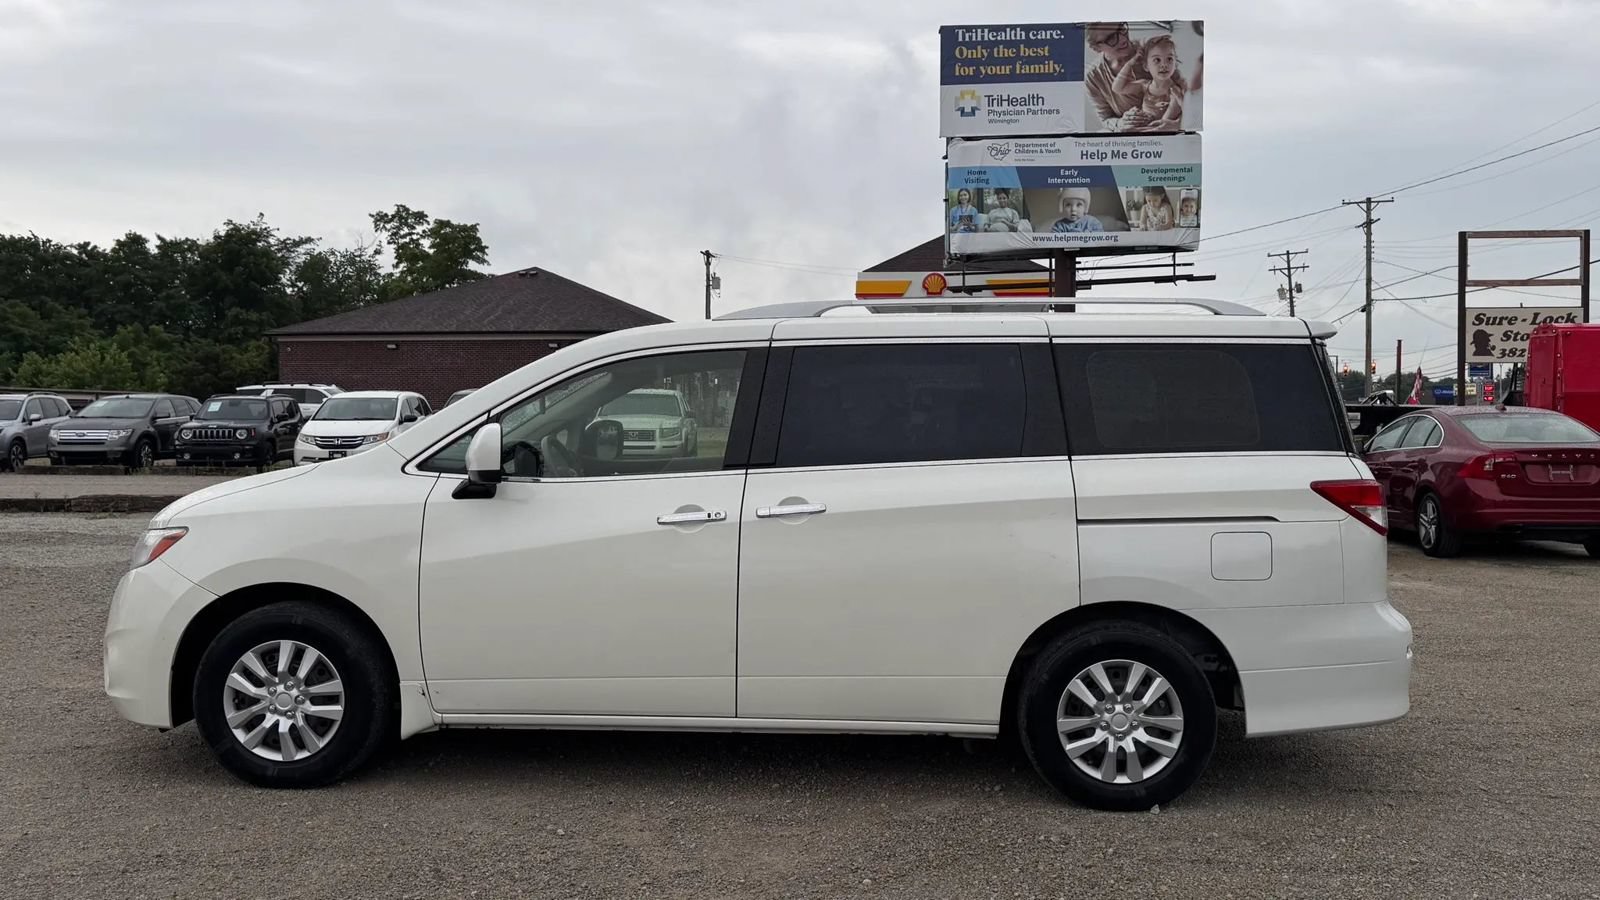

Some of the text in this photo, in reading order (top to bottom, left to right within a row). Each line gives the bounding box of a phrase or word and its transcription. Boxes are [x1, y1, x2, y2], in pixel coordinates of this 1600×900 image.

[955, 28, 1064, 41] TriHealth care.
[955, 44, 1049, 61] Only the best
[955, 60, 1064, 78] for your family.
[984, 93, 1045, 107] TriHealth
[987, 107, 1060, 118] Physician Partners
[1112, 140, 1136, 148] thriving
[1080, 149, 1163, 162] Help Me Grow
[1060, 169, 1078, 177] Early
[1141, 166, 1193, 174] Developmental
[964, 177, 990, 185] Visiting
[1147, 174, 1186, 182] Screenings
[1032, 234, 1119, 243] www.helpmegrow.org
[1500, 330, 1530, 342] Sto
